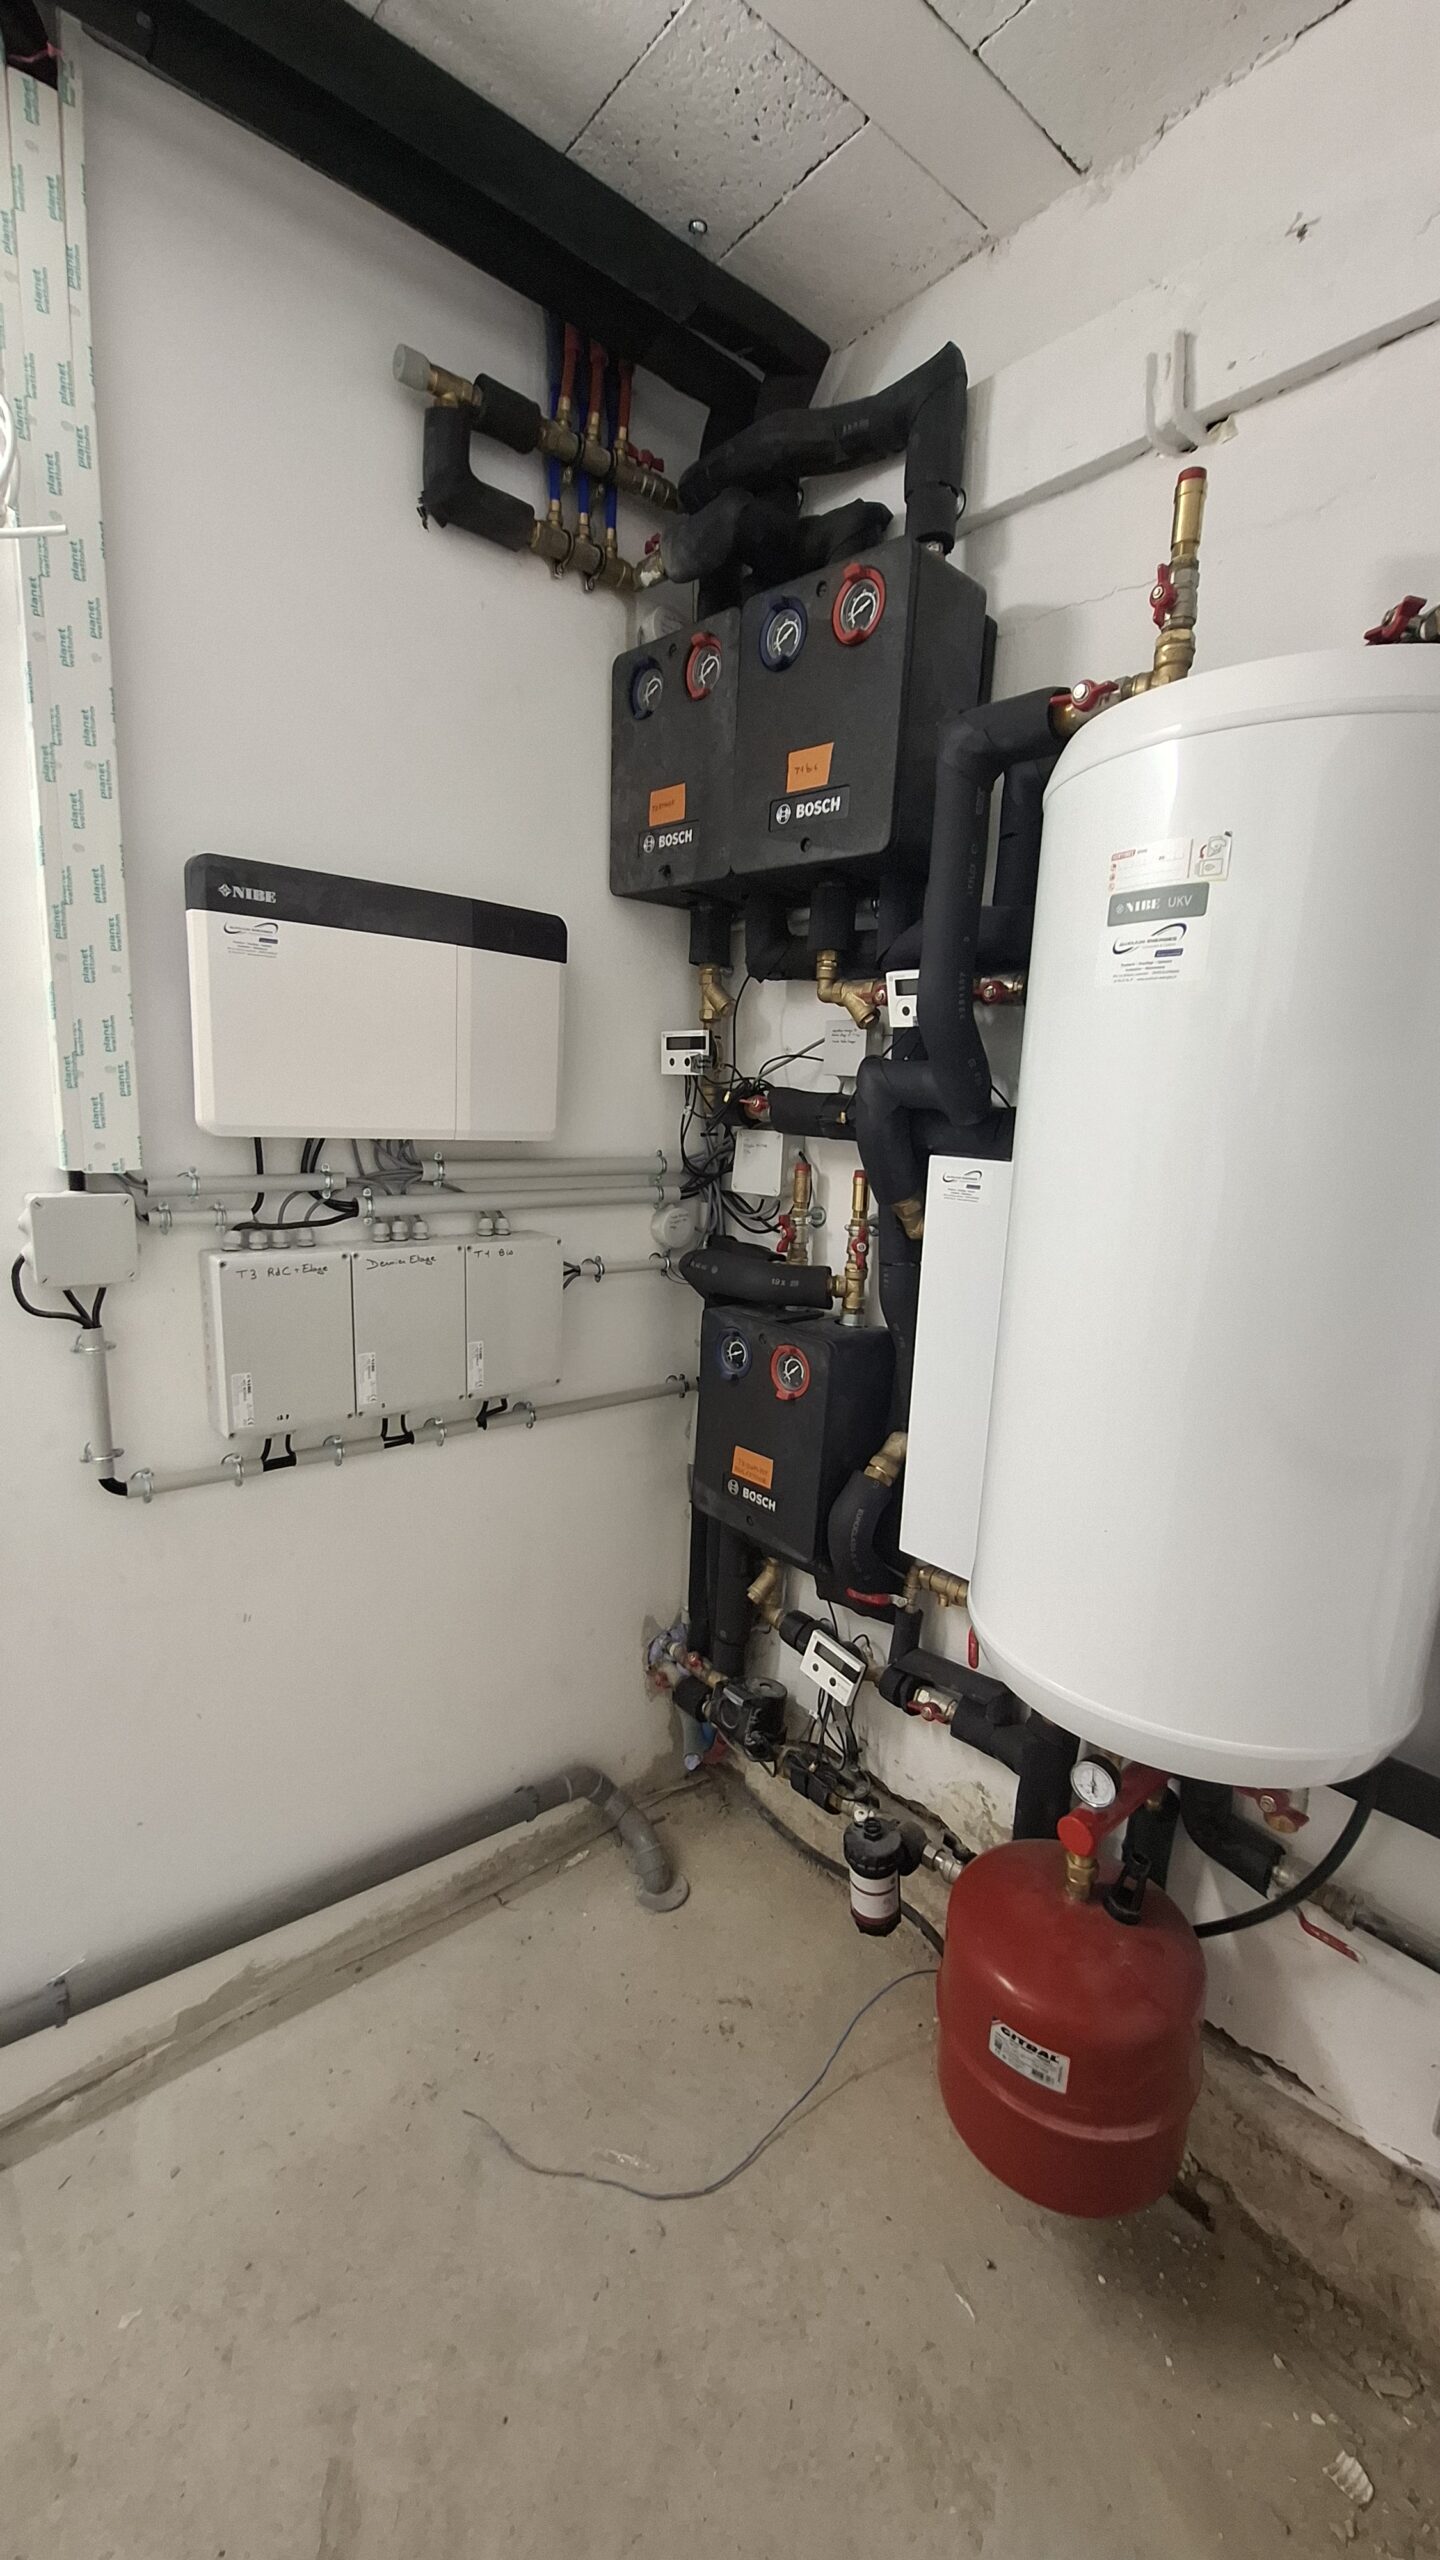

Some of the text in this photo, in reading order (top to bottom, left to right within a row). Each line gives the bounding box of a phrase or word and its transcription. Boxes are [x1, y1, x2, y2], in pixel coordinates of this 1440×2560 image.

[46, 176, 58, 221] planet
[33, 269, 46, 313] planet
[58, 363, 70, 406] planet
[14, 398, 27, 441] planet
[76, 426, 88, 469] planet
[45, 453, 58, 495] planet
[69, 541, 81, 581] planet
[29, 576, 41, 617] planet
[87, 600, 99, 639] planet
[58, 628, 69, 667] planet
[81, 709, 92, 746] planet
[41, 745, 53, 782] planet
[98, 763, 108, 799] planet
[69, 793, 81, 829] planet
[795, 796, 841, 819] BOSCH
[658, 829, 693, 849] BOSCH
[91, 868, 101, 903] planet
[231, 885, 277, 904] NIBE
[51, 904, 63, 939] planet
[1125, 895, 1192, 913] NIBE UKV
[108, 918, 118, 952] planet
[80, 949, 91, 983] planet
[102, 1019, 112, 1052] planet
[63, 1055, 74, 1089] planet
[118, 1064, 128, 1097] planet
[90, 1096, 101, 1129] planet
[267, 1266, 291, 1277] RdC
[742, 1487, 776, 1512] BOSCH
[1001, 2026, 1060, 2064] CITRAL
